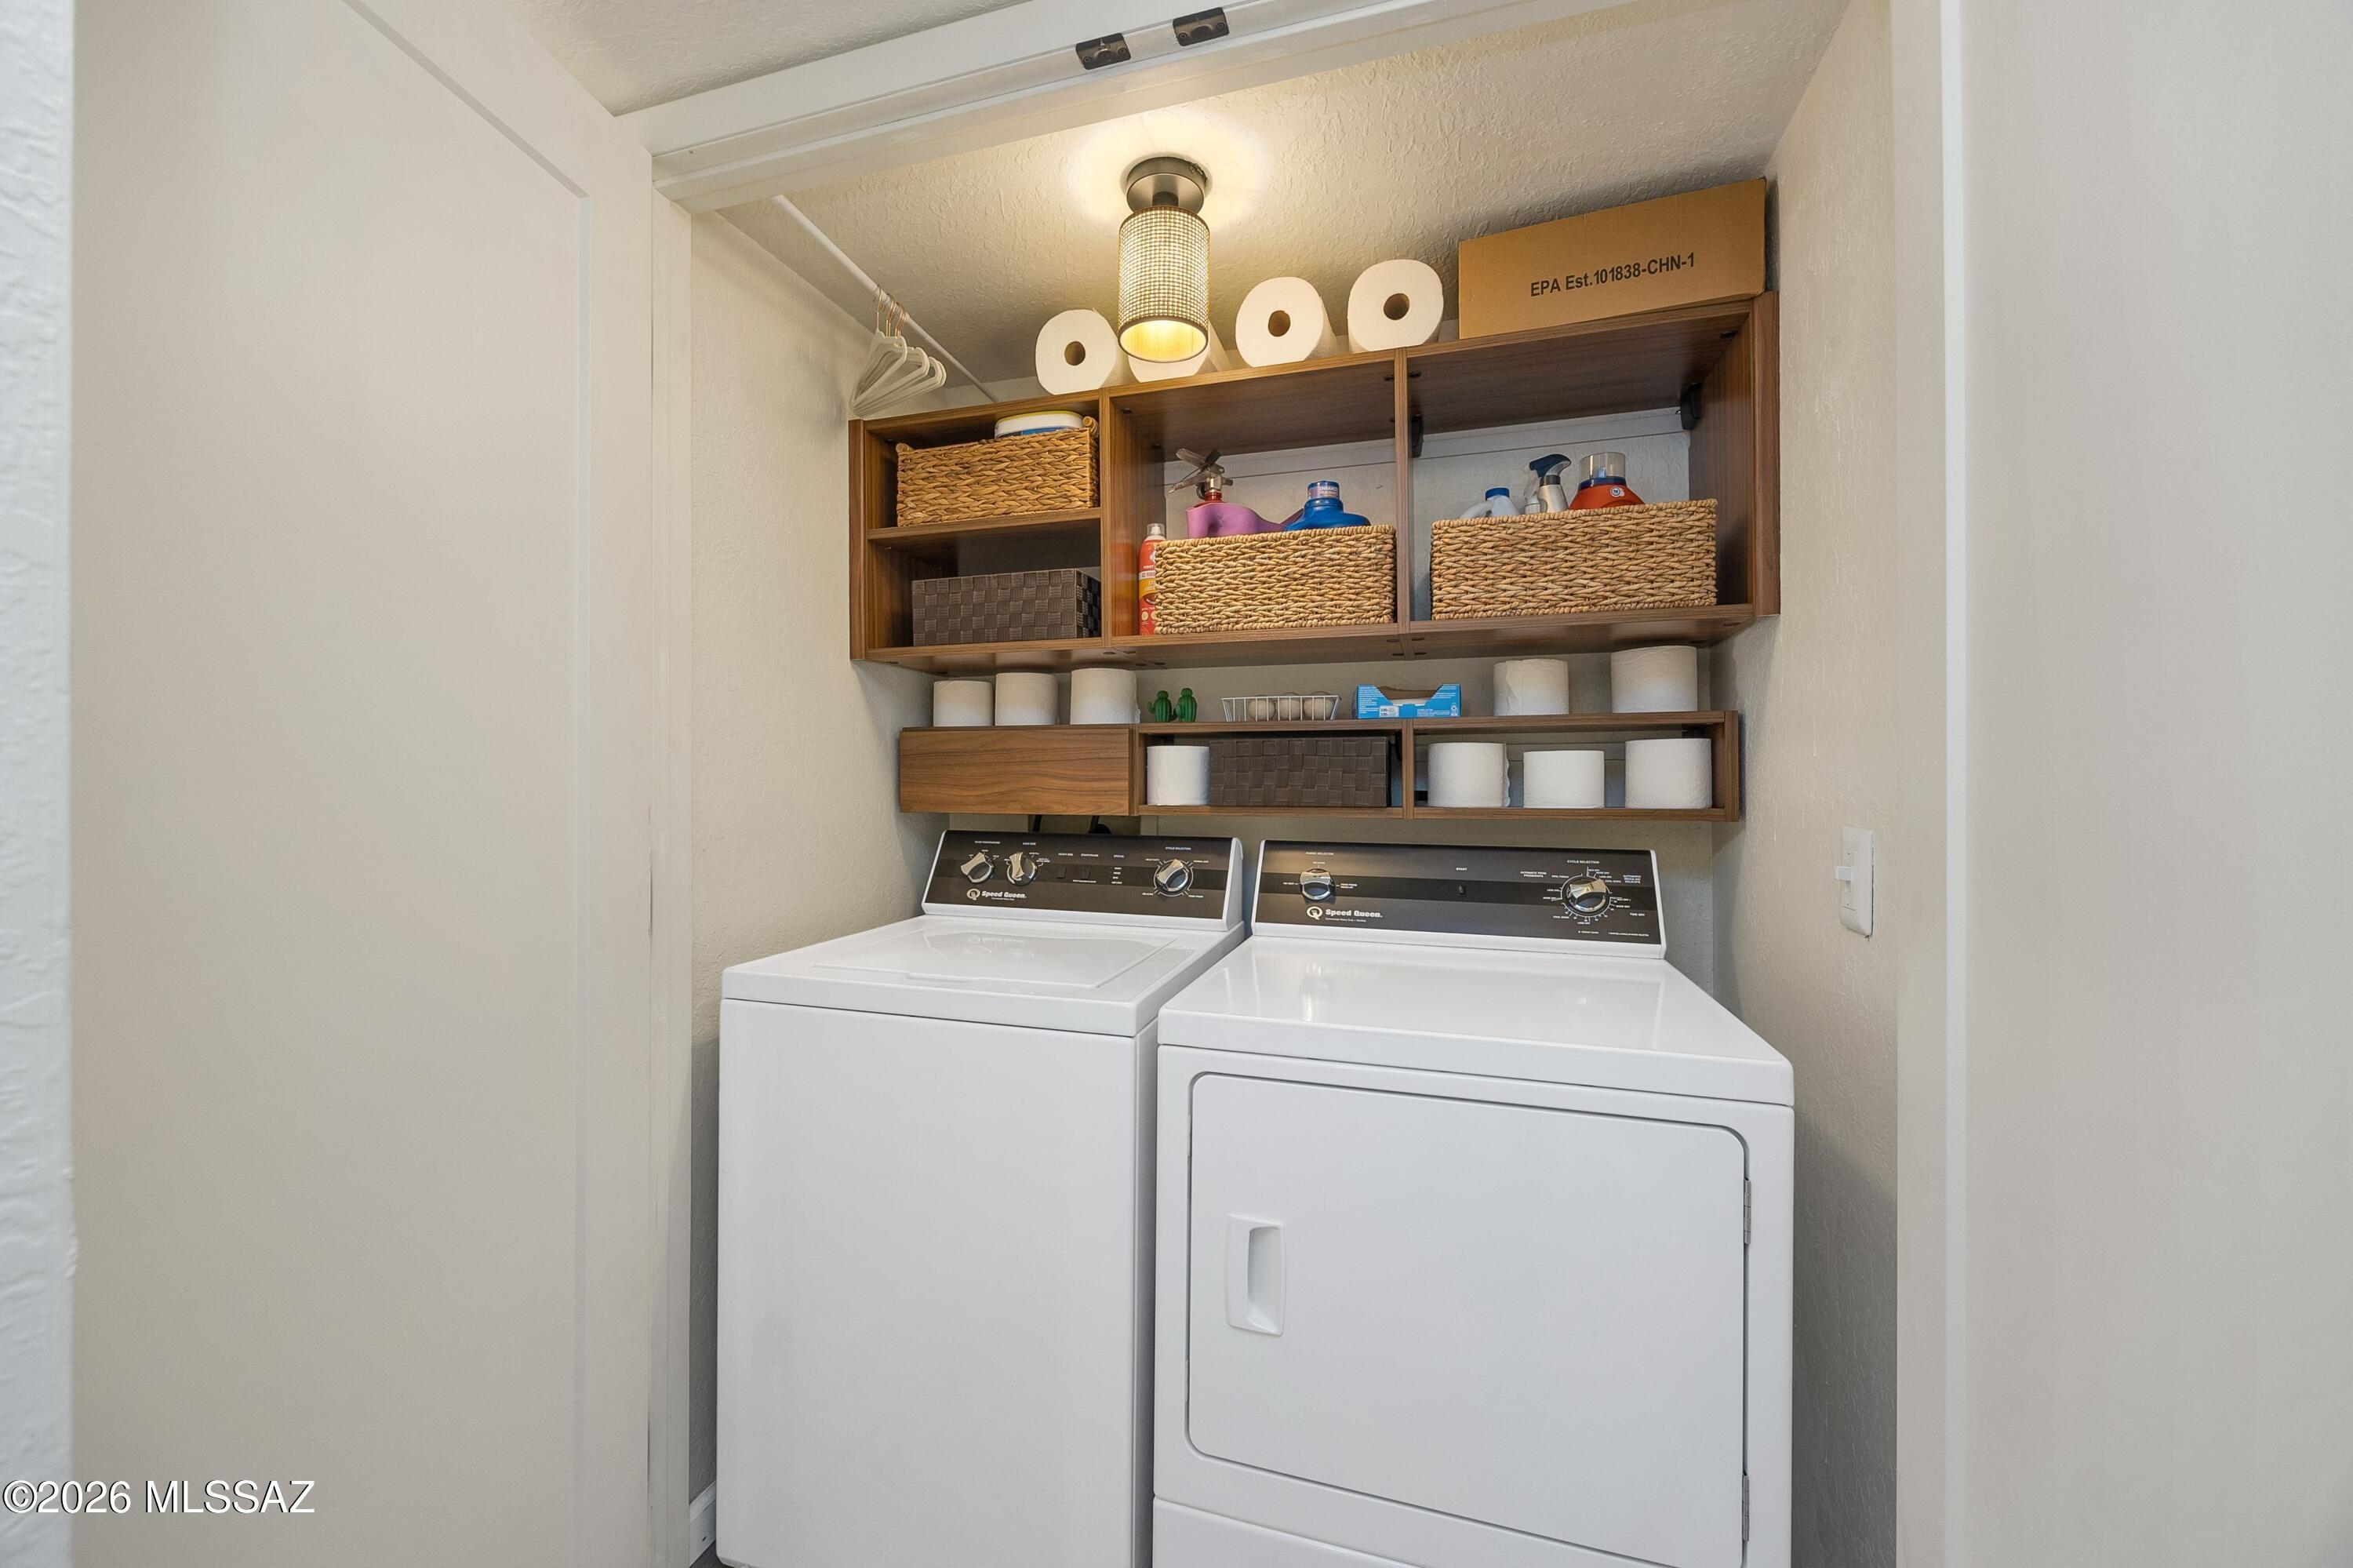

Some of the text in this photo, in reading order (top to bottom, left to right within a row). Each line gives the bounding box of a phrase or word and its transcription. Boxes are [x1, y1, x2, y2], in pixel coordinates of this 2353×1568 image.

[1530, 252, 1695, 297] EPA Est.101838-CHN-1
[1325, 908, 1352, 917] Speed
